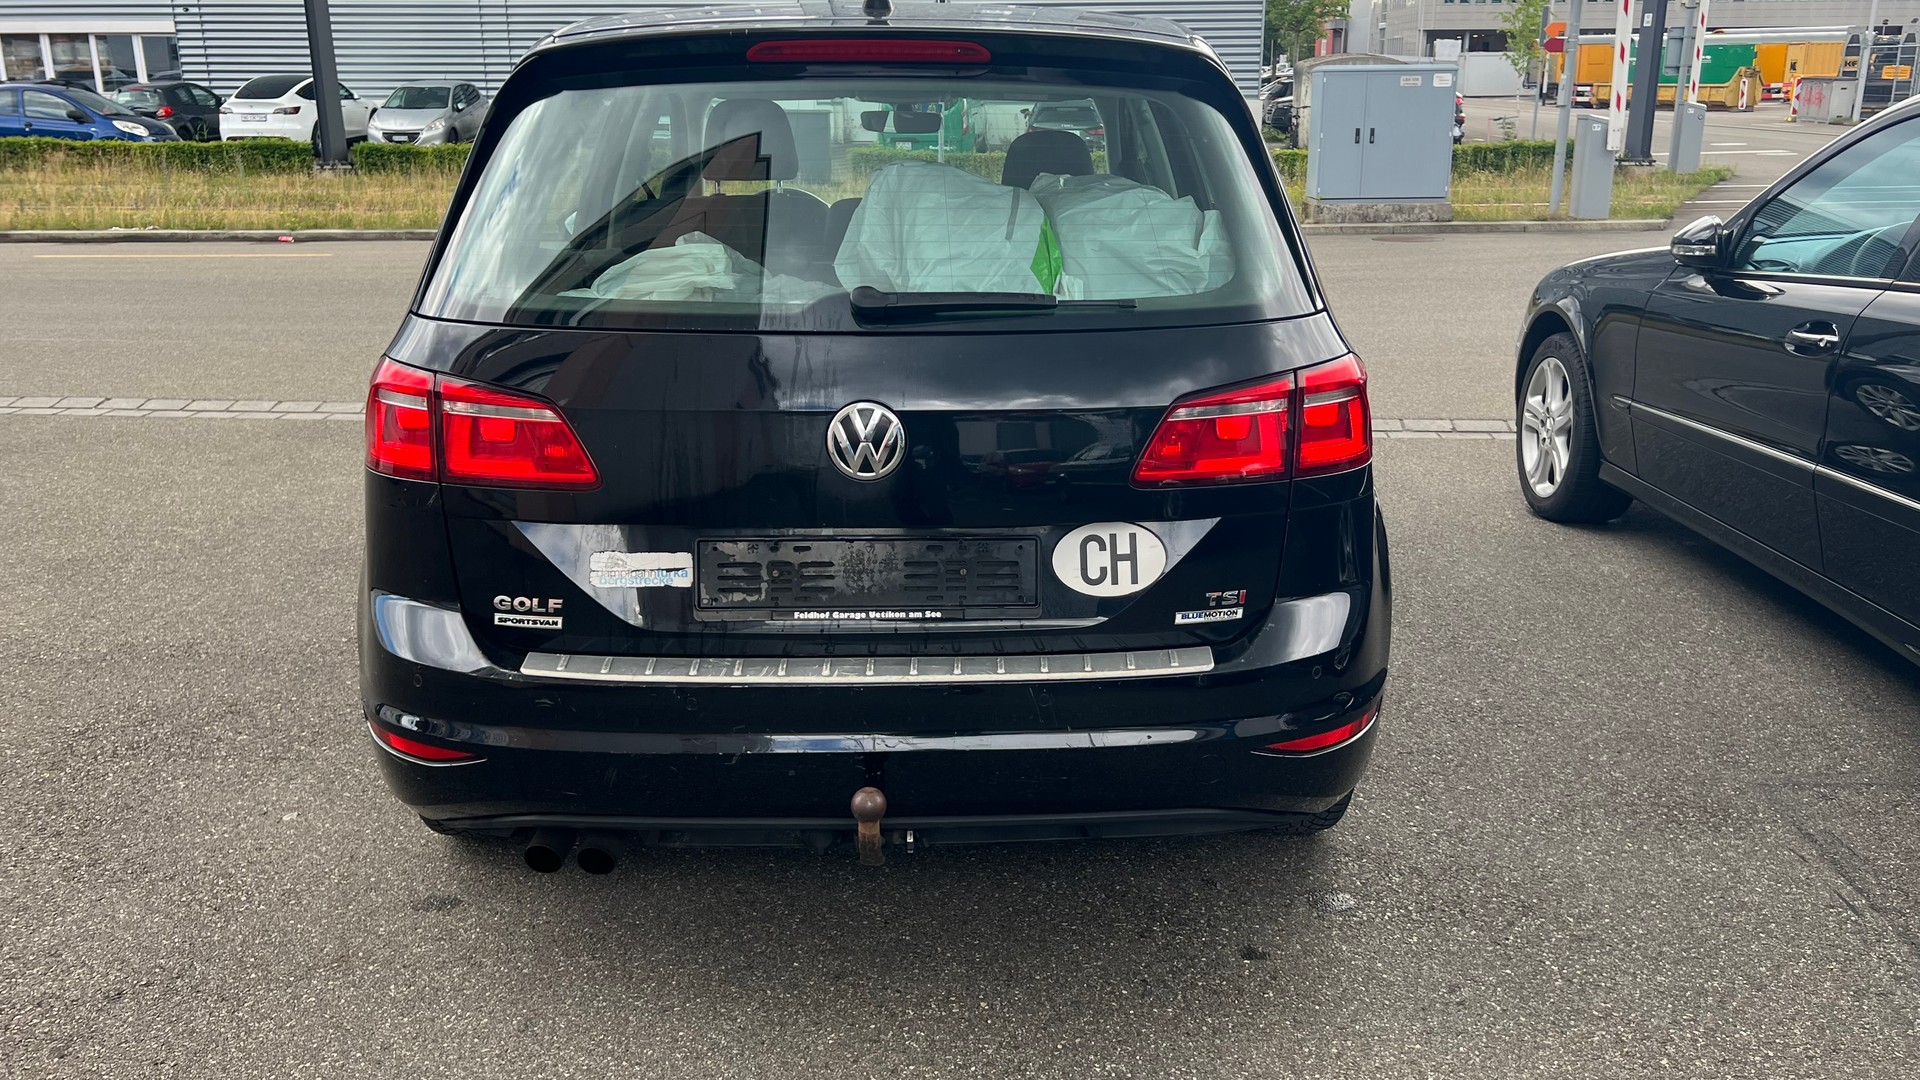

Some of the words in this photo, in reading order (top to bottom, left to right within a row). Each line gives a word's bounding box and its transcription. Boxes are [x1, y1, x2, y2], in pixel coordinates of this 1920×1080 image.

[831, 404, 900, 478] VW
[1079, 532, 1139, 586] CH
[600, 575, 673, 587] bergstrecke
[493, 595, 564, 613] GOLF
[1205, 589, 1247, 606] TSI
[497, 616, 559, 627] SPORTSVAN
[793, 611, 830, 619] Feldhof
[832, 611, 867, 620] Garage
[869, 610, 906, 619] Uetikon
[925, 610, 942, 618] See
[1181, 609, 1239, 620] BLUEMOTION
